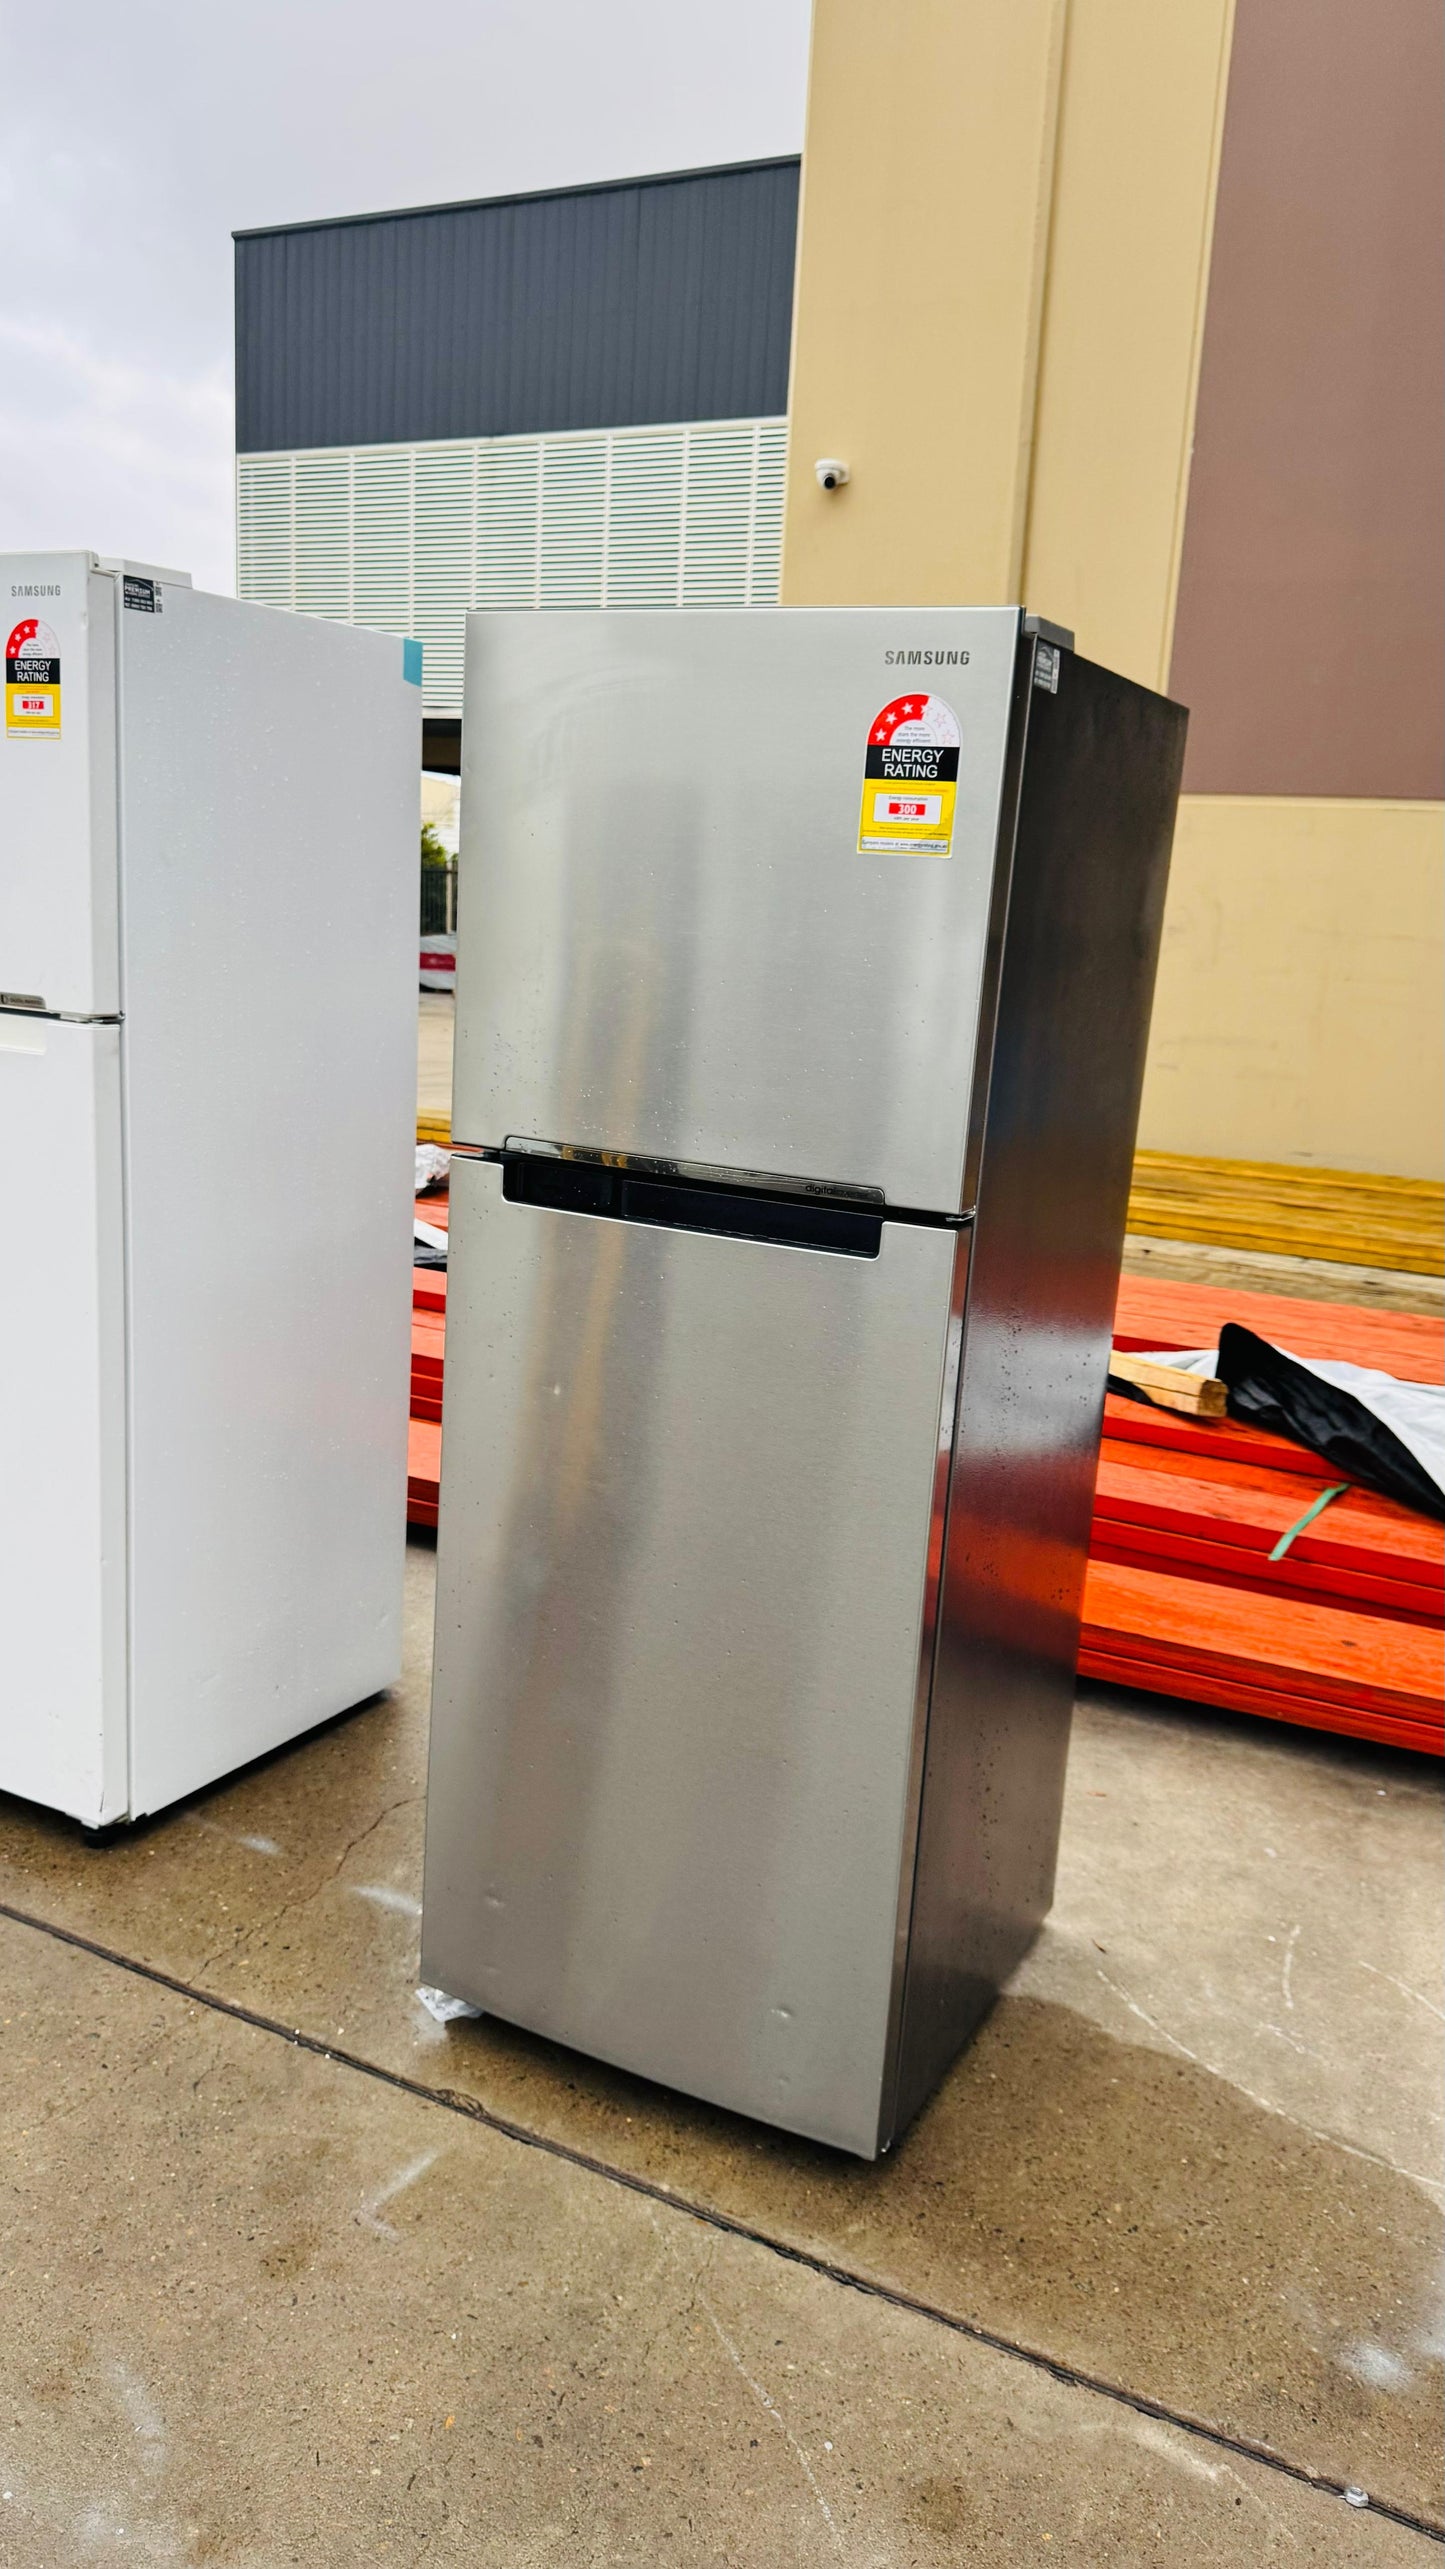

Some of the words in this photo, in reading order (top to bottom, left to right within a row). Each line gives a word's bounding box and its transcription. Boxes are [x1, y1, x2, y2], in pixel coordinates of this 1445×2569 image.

[11, 585, 61, 597] SAMSUNG
[884, 650, 970, 666] SAMSUNG
[14, 660, 51, 671] ENERGY
[16, 672, 49, 683] RATING
[882, 748, 944, 763] ENERGY
[884, 763, 938, 779] RATING
[898, 804, 917, 815] 300
